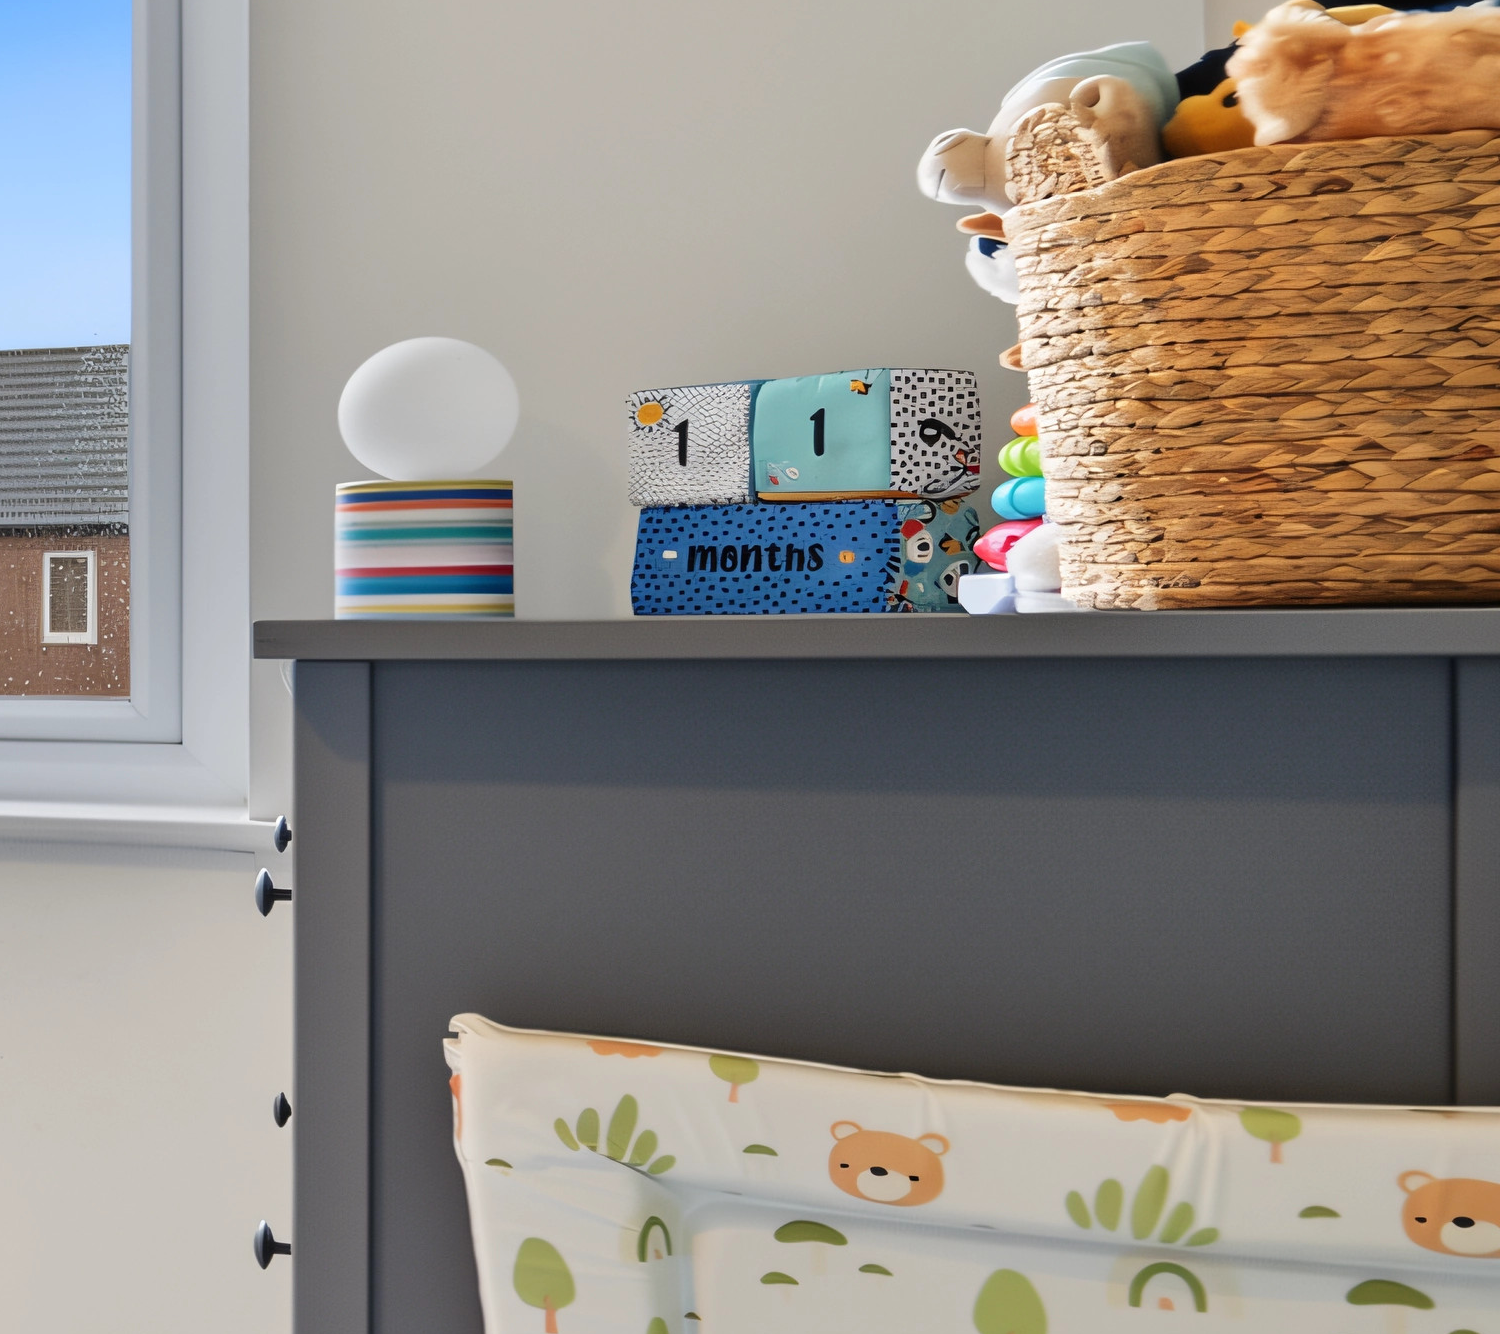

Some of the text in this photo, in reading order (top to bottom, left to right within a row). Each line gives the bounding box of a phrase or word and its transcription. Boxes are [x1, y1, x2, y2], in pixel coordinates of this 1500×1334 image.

[672, 408, 826, 467] 1 1
[686, 542, 825, 573] months
